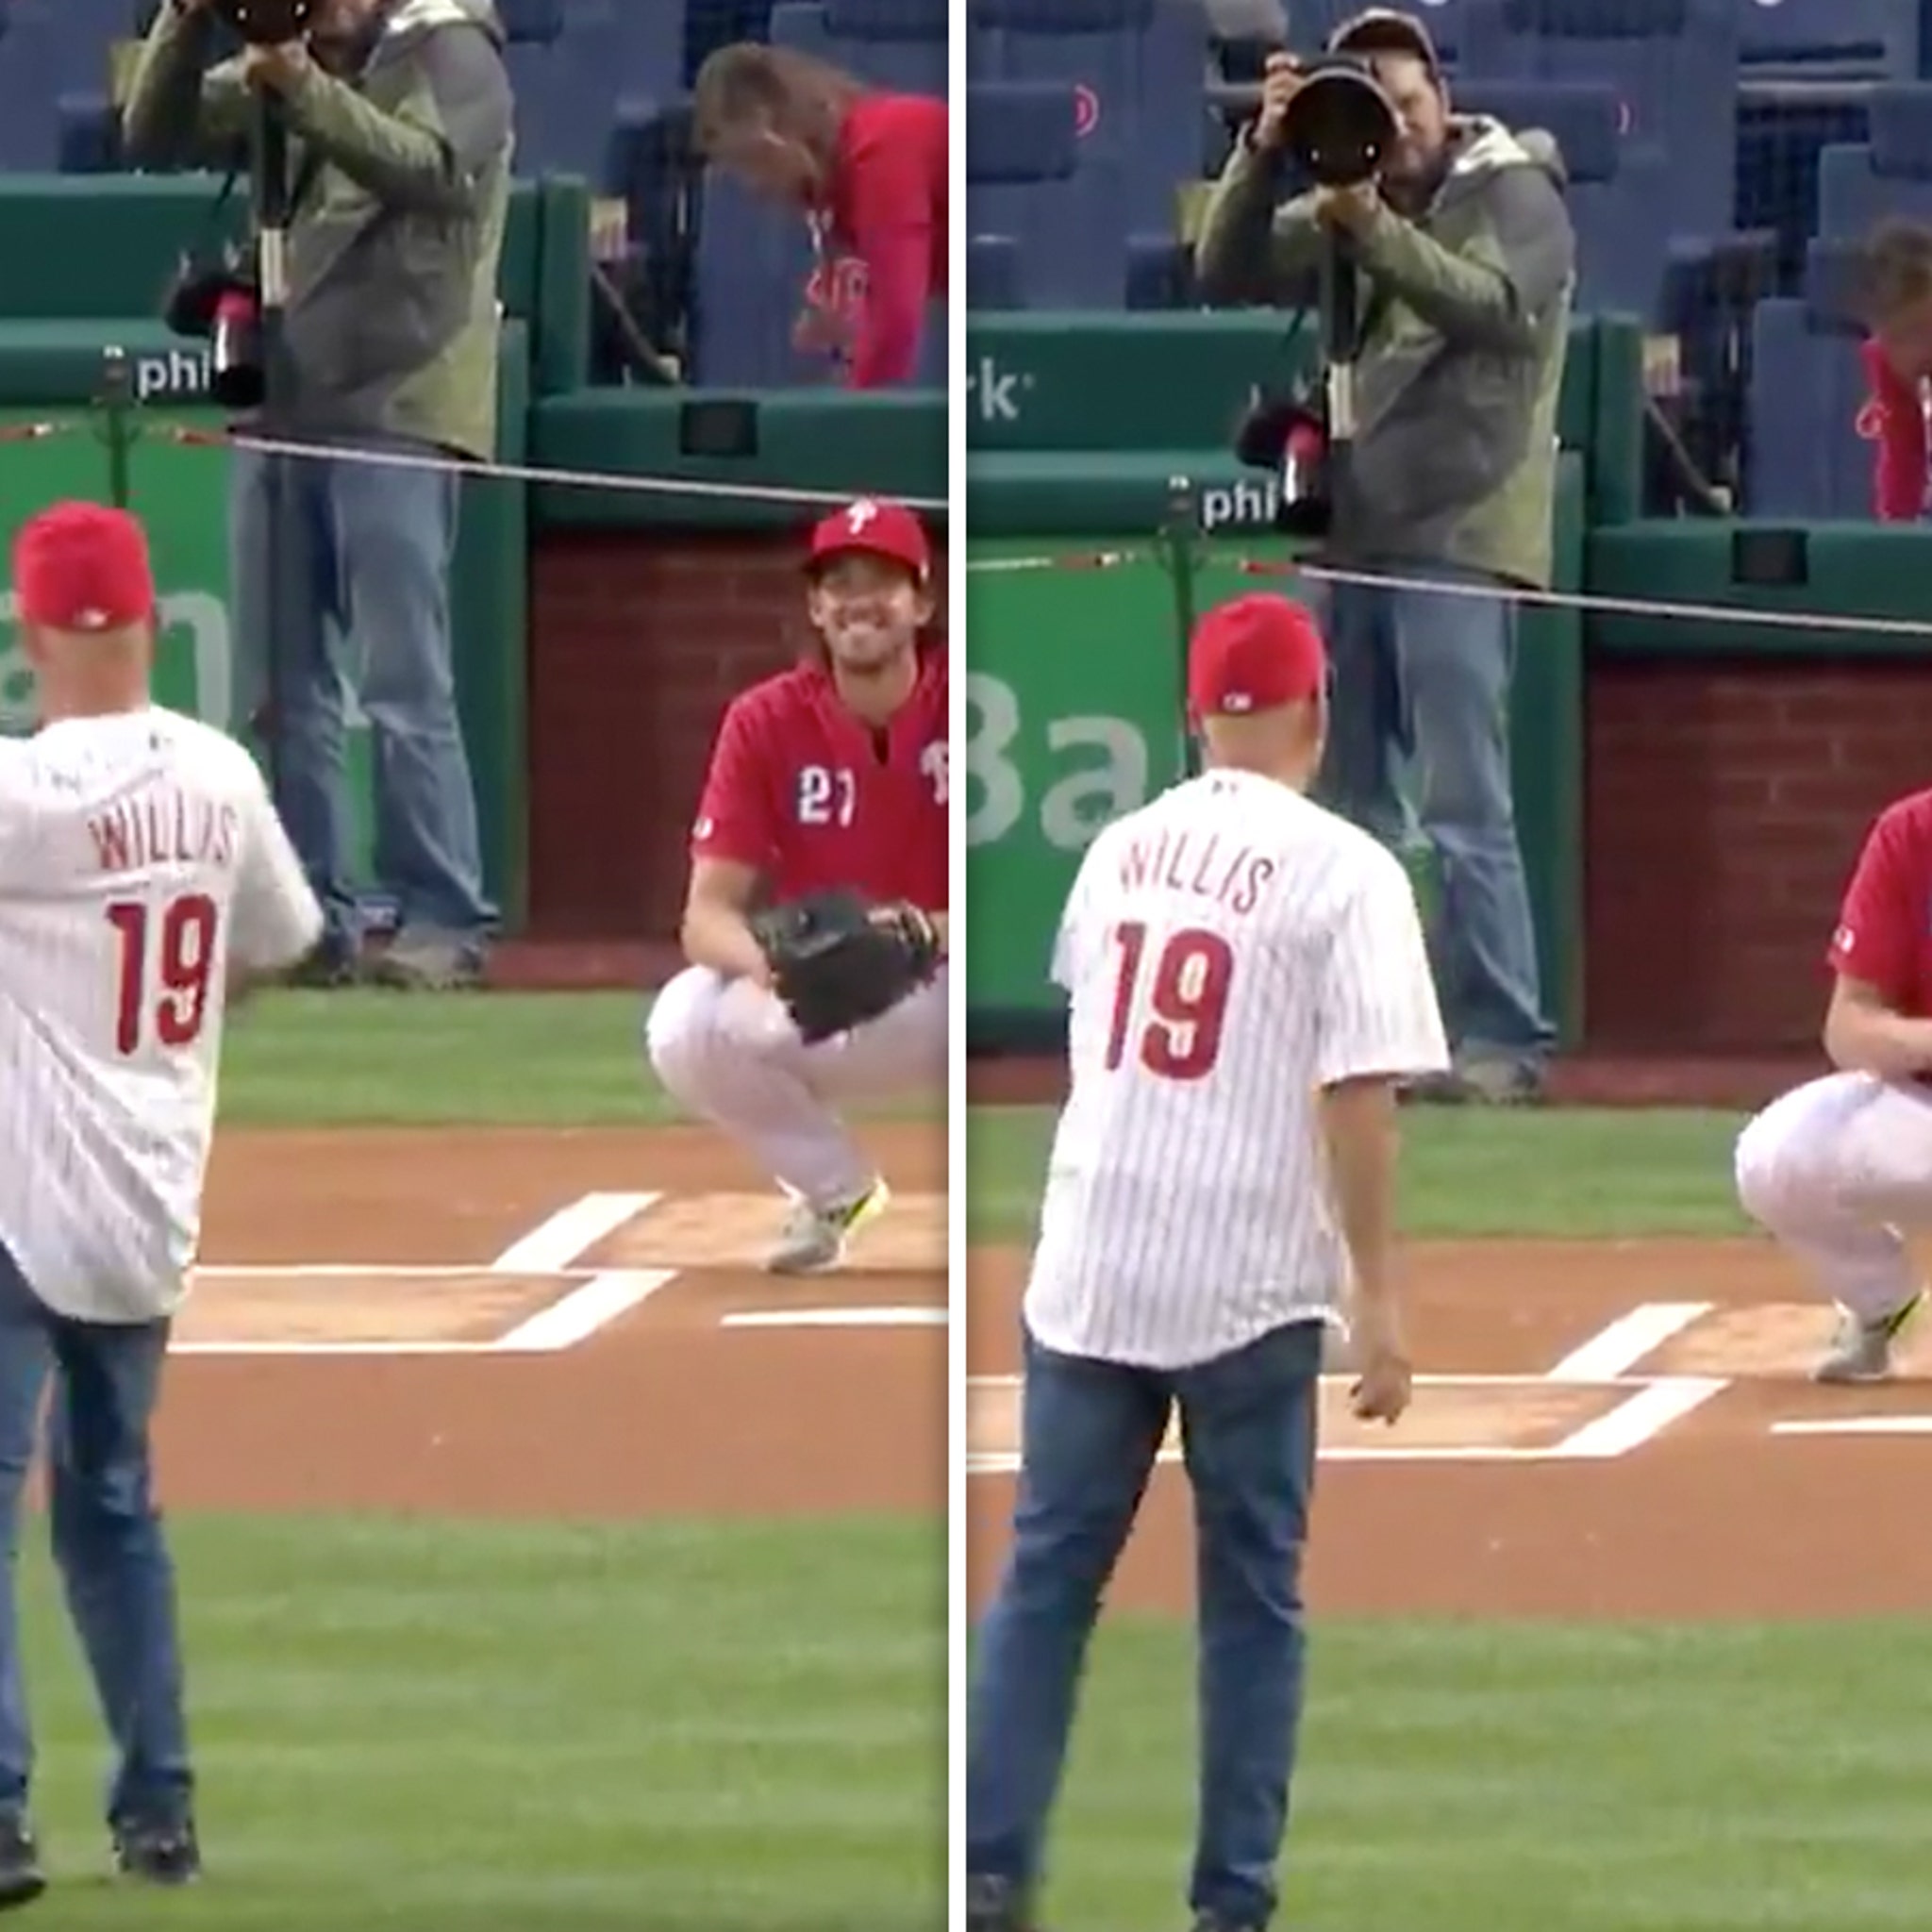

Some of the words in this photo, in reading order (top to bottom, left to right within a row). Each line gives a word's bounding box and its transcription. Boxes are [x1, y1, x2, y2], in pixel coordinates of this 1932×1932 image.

[88, 789, 238, 870] WILLIS
[1120, 826, 1274, 915] WILLIS
[105, 893, 217, 1056] 19
[1106, 921, 1233, 1080] 19
